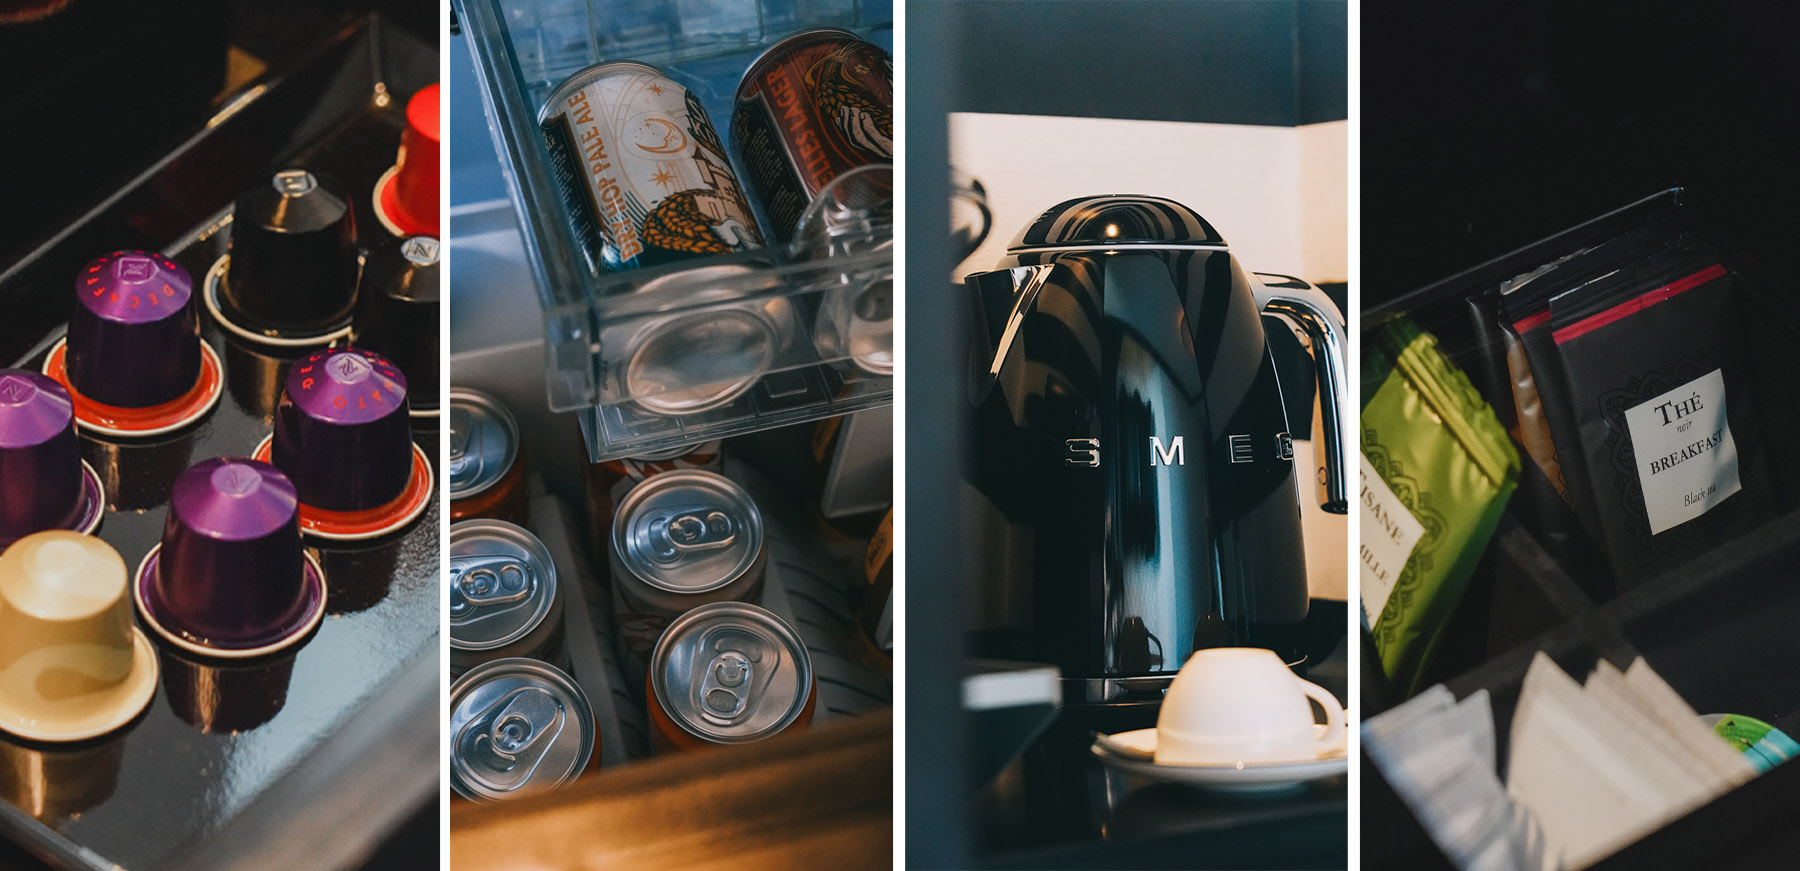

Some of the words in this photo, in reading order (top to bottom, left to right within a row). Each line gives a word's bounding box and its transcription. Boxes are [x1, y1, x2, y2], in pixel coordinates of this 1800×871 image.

[567, 90, 595, 125] ALE
[766, 64, 809, 133] LAGER
[580, 126, 612, 176] PALE
[794, 128, 837, 194] ELLES
[597, 177, 627, 219] HOP
[610, 218, 644, 263] DRY
[1676, 419, 1693, 433] noir
[1649, 428, 1724, 475] BREAKFAST
[1683, 487, 1706, 507] Black
[1707, 483, 1717, 496] tea
